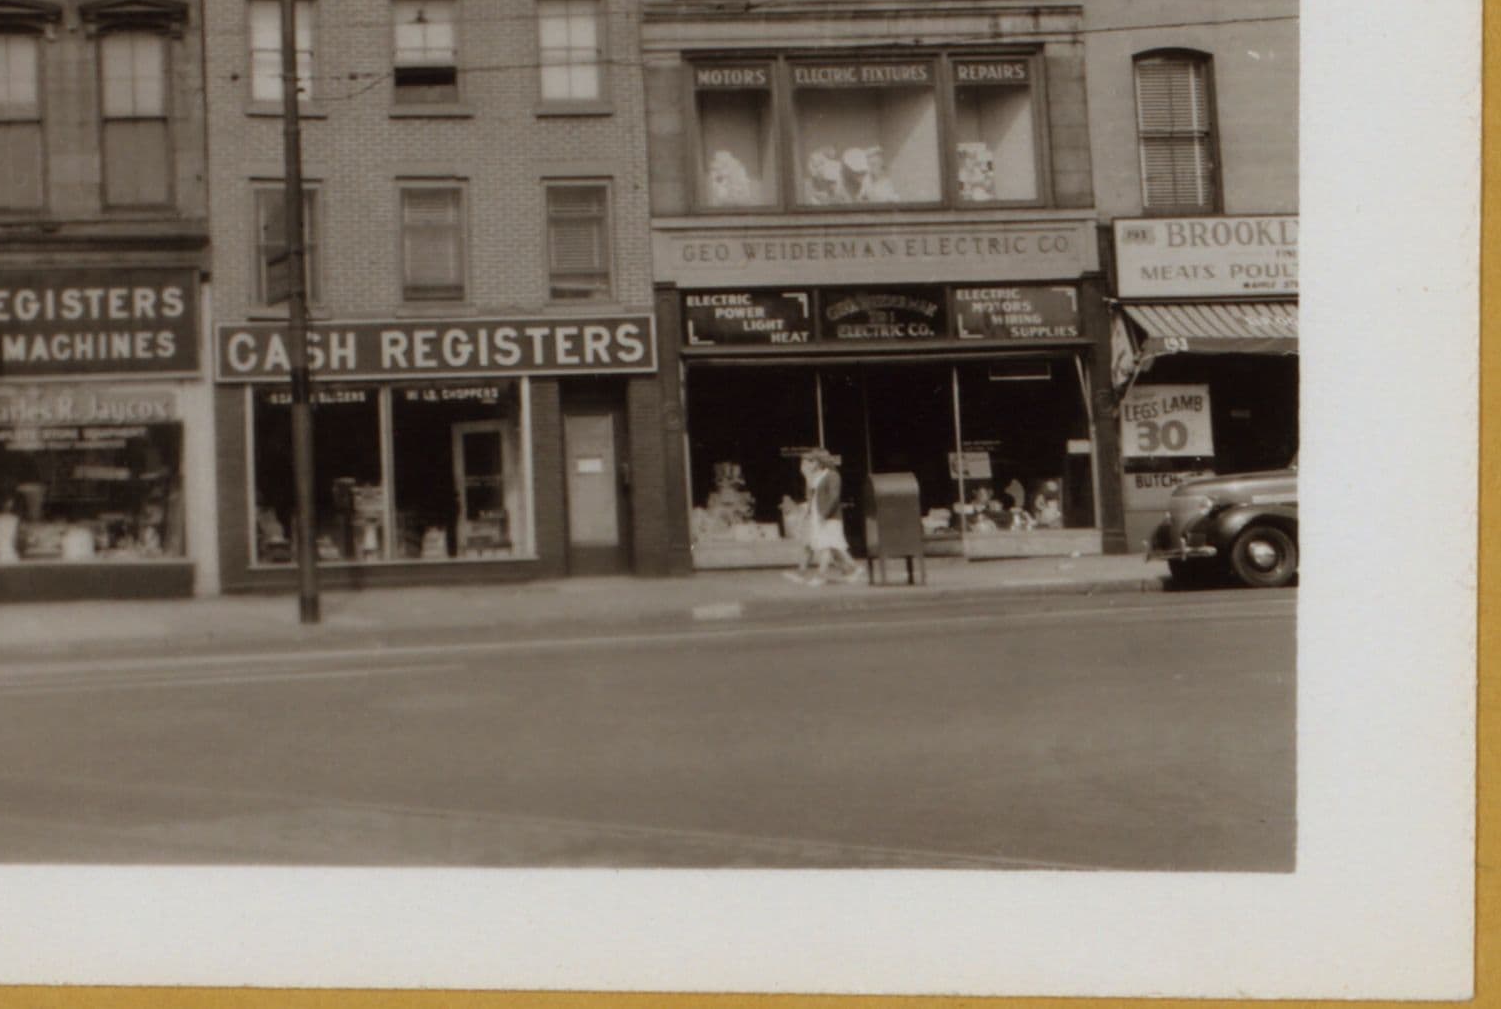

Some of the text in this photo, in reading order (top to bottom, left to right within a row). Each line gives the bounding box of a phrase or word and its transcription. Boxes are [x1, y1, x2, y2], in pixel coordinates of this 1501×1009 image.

[699, 69, 766, 85] MOTORS
[795, 65, 928, 84] ELECTRIC FIXTURES
[957, 63, 1025, 80] REPAIRS
[682, 243, 731, 262] GEO
[741, 240, 896, 261] WEIDERMAN
[904, 235, 1027, 256] ELECTRIC
[1140, 264, 1214, 280] MEATS
[686, 293, 752, 307] ELECTRIC
[956, 289, 1021, 302] ELECTRIC
[715, 306, 765, 319] POWER
[743, 319, 785, 331] LIGHT
[837, 325, 904, 339] ELECTRIC
[1011, 326, 1077, 338] SUPPLIES
[771, 331, 810, 343] HEAT
[2, 331, 176, 362] MACHINES
[380, 324, 645, 369] REGISTERS
[1124, 395, 1203, 422] LEGS LAMB
[1136, 420, 1188, 452] 30
